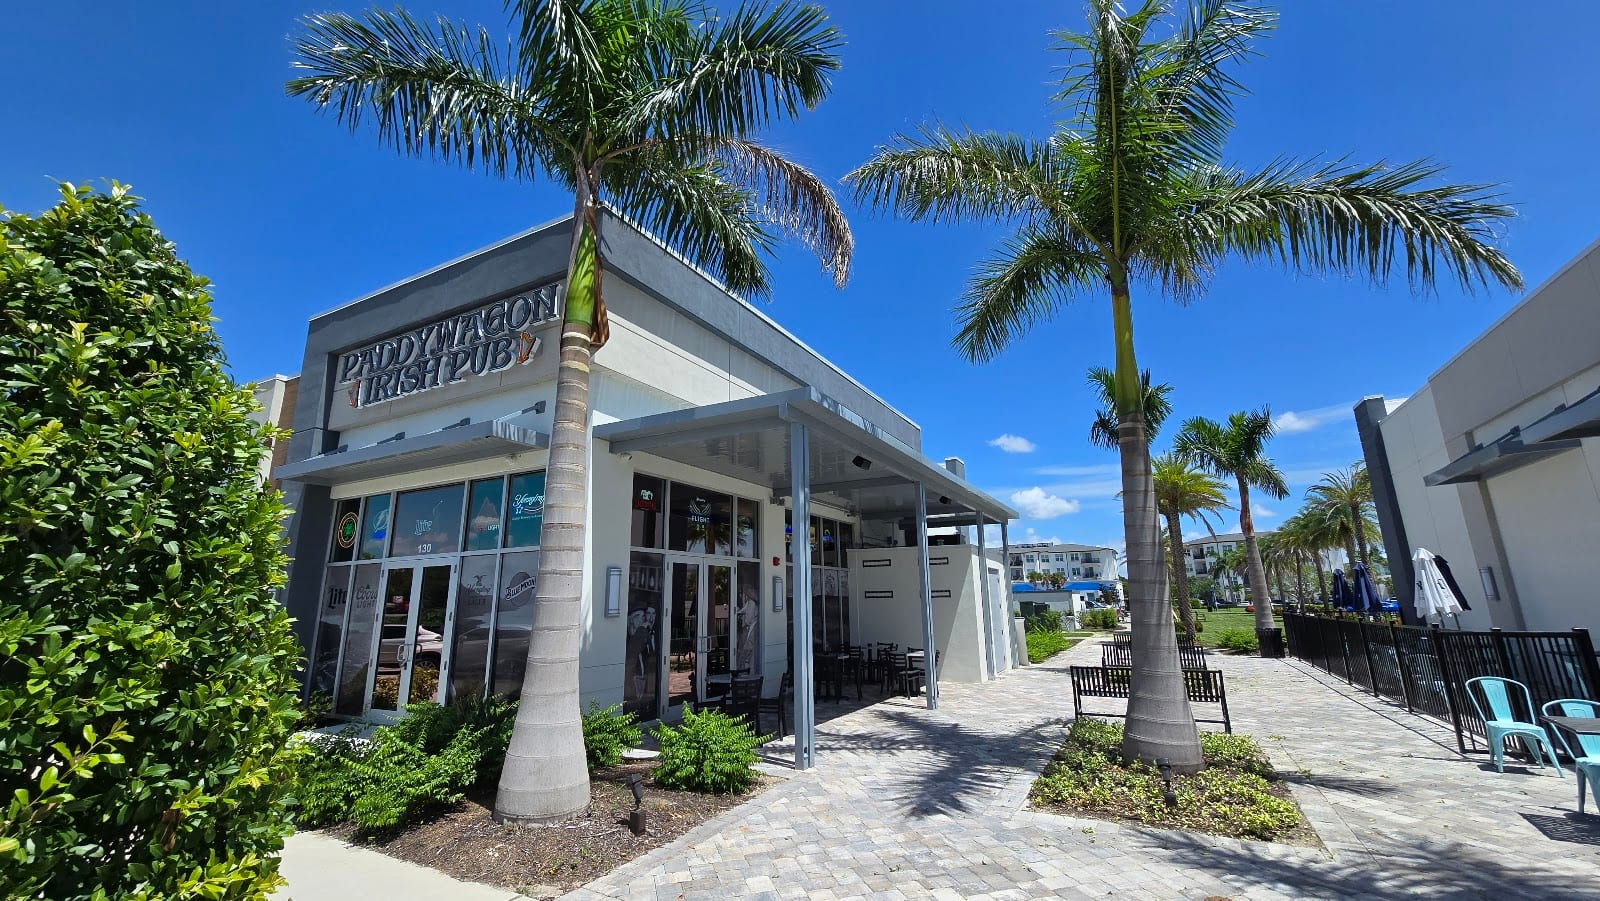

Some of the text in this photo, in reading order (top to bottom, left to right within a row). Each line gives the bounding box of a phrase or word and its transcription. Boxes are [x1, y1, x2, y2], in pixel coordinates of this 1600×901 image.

[338, 283, 561, 384] PADDYWAGON
[360, 338, 516, 408] IRISH PUB
[417, 543, 433, 554] 130
